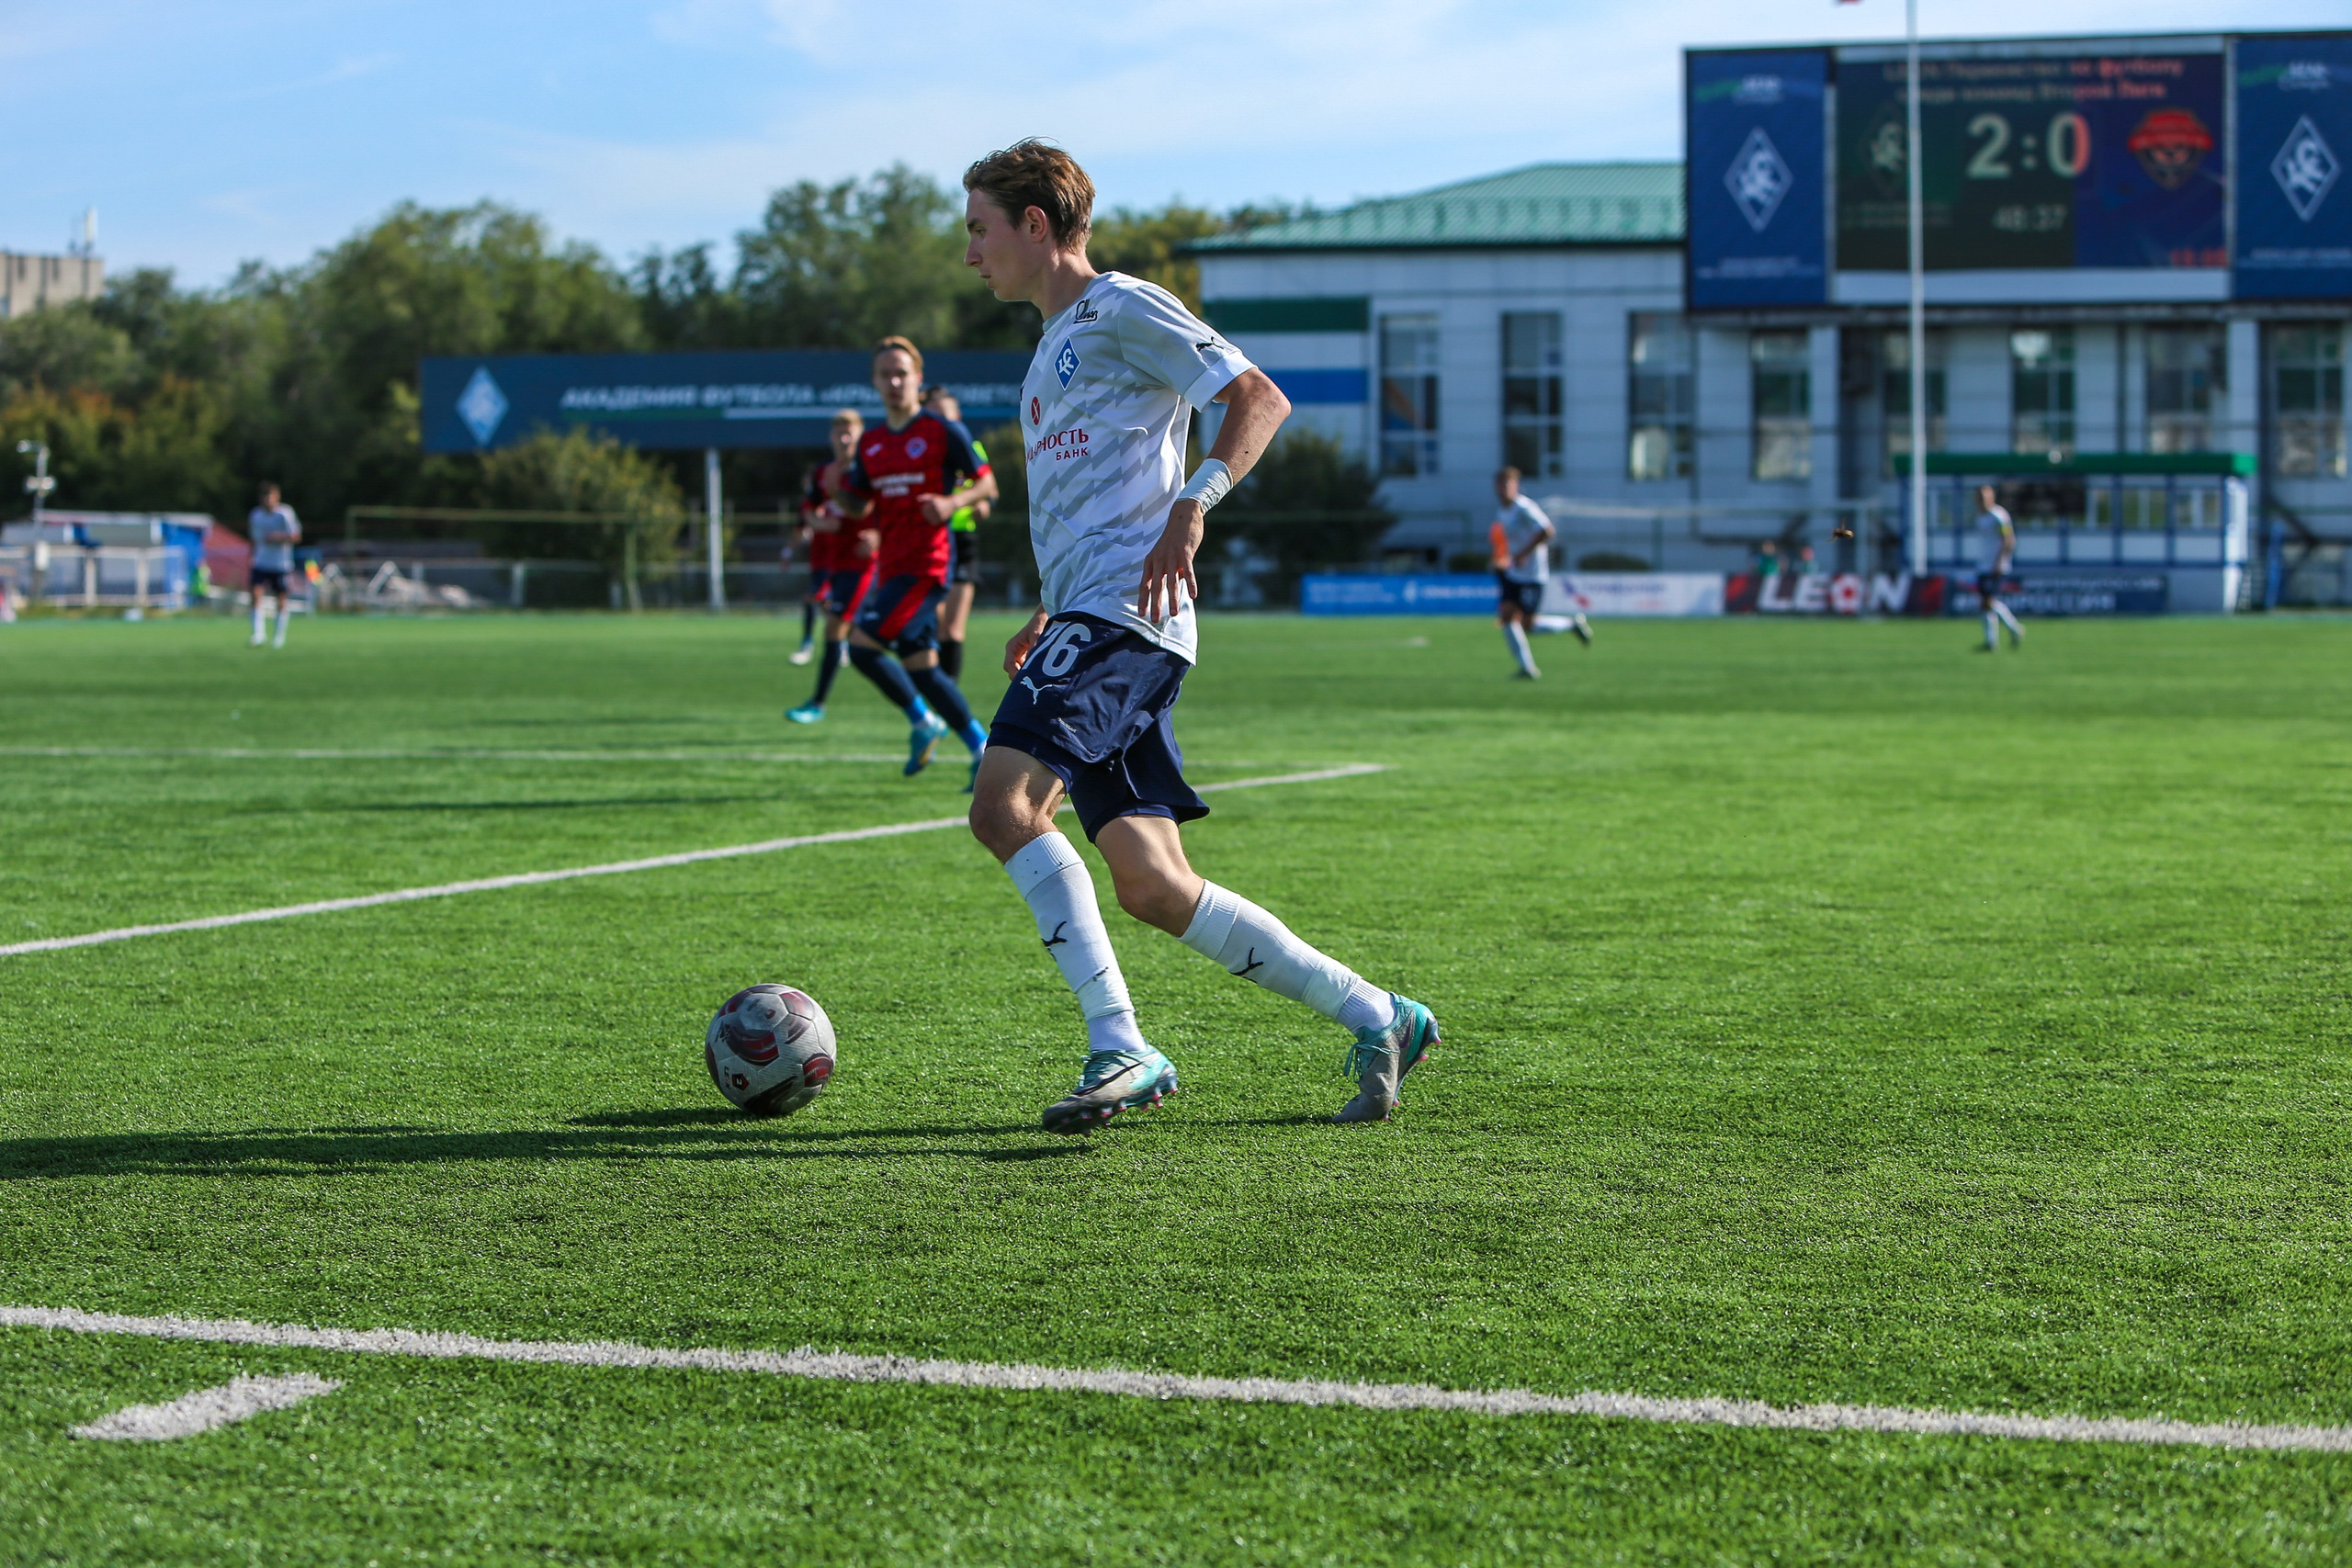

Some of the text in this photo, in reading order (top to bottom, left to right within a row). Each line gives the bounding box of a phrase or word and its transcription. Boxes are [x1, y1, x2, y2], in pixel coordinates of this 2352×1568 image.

[1967, 114, 2091, 177] 2:0
[560, 386, 696, 410] АКАДЕМИЯ
[700, 384, 815, 406] ФУТБОЛА
[1057, 446, 1089, 461] БАНК
[1756, 571, 1911, 611] LEON
[1022, 620, 1091, 677] 76
